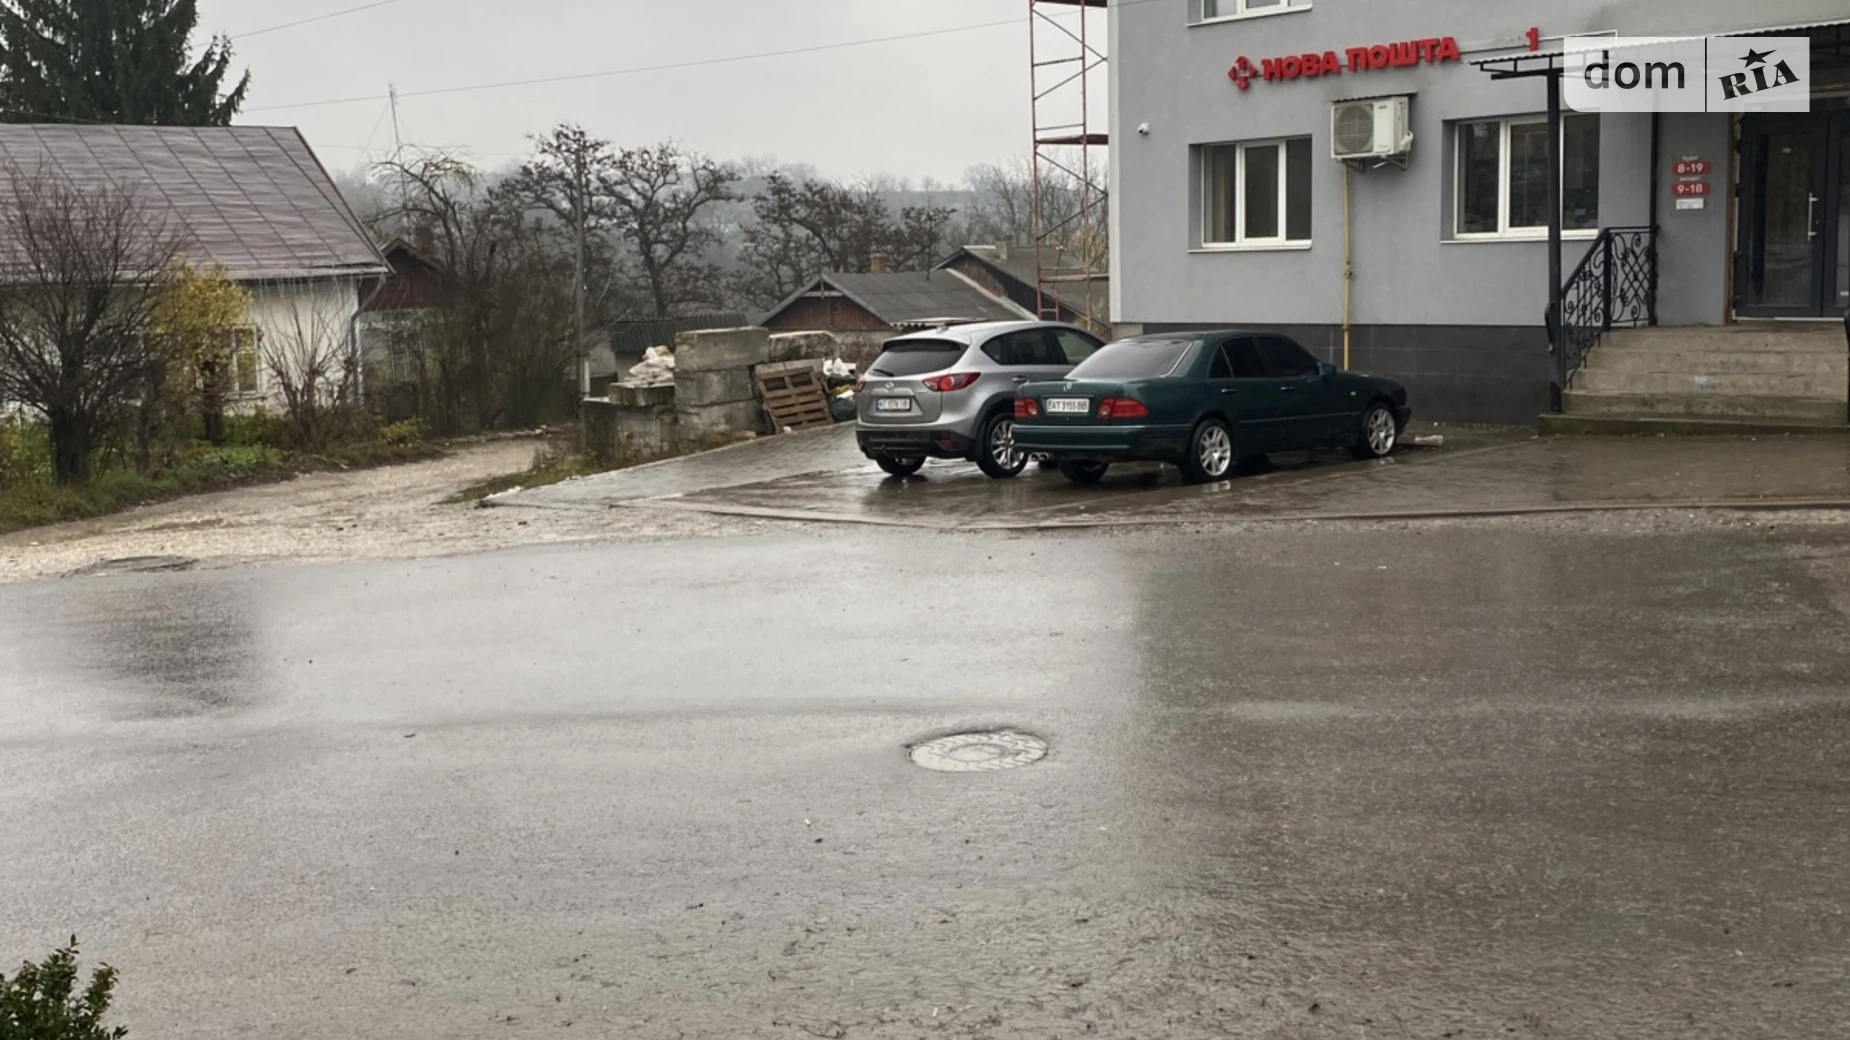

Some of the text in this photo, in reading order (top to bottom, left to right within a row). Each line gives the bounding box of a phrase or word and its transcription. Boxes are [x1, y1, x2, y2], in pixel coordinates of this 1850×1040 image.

[1262, 27, 1539, 81] НОВА ПОШТА 1
[1677, 163, 1704, 174] 8-19
[1677, 183, 1703, 194] 9-18
